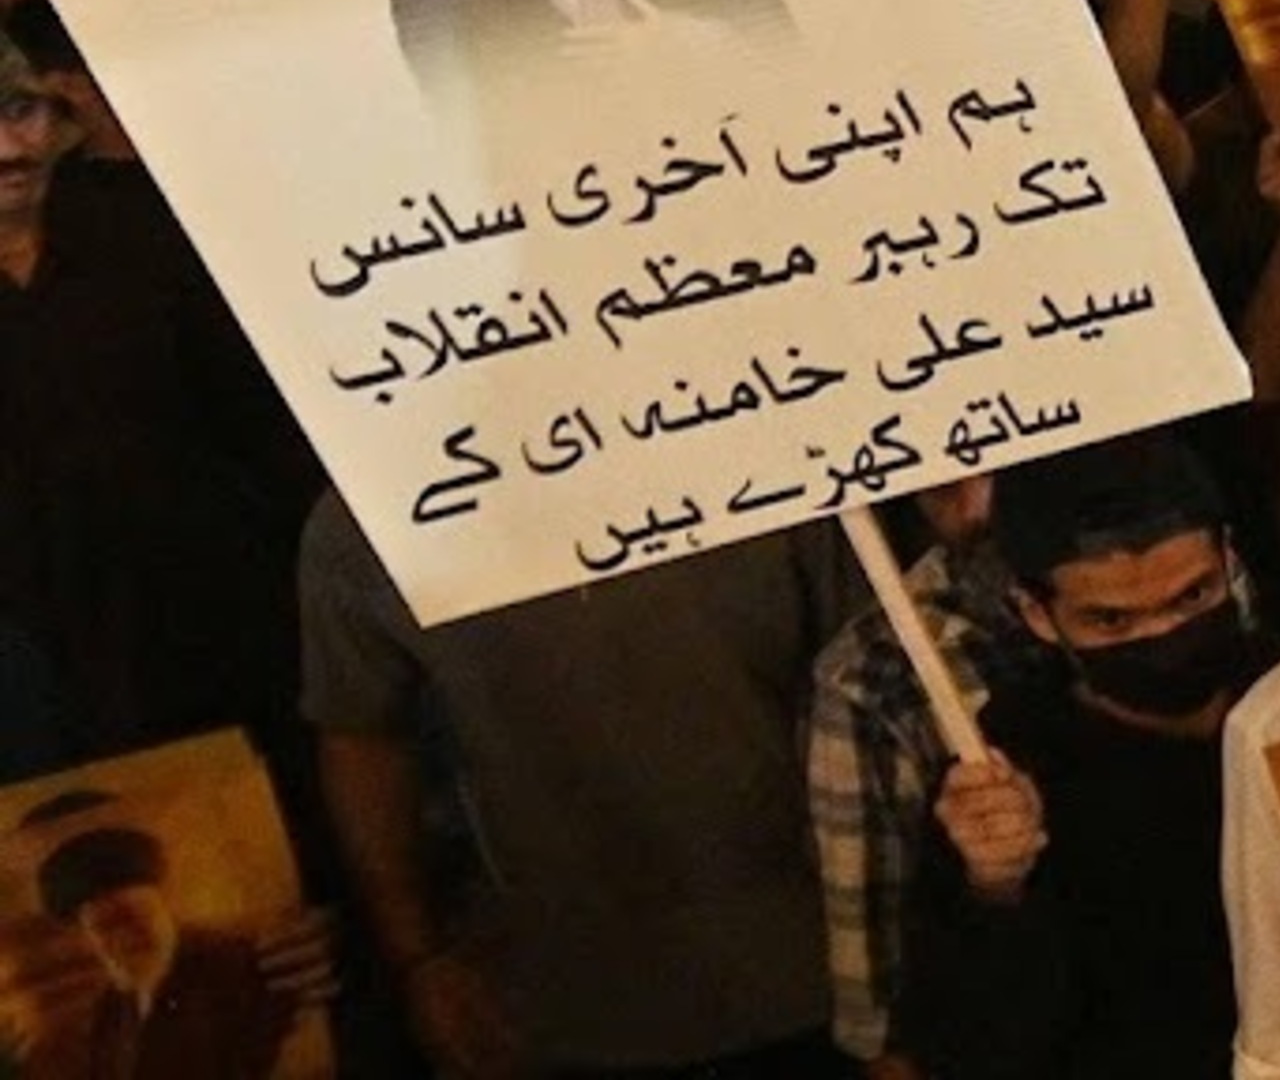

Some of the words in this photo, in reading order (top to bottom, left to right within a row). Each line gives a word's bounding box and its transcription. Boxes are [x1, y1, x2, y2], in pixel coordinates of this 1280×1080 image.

[775, 89, 922, 184] اپنی
[947, 78, 1037, 152] ہم
[993, 157, 1107, 225] تک
[310, 192, 527, 297] سانس
[852, 213, 980, 284] رہبر
[595, 244, 817, 349] معظم
[1026, 284, 1155, 342] سید
[331, 289, 568, 407] انقلاب
[876, 313, 1003, 393] علی
[521, 407, 603, 476] ای
[726, 414, 922, 514] کھڑے
[944, 392, 1081, 466] ساتھ
[410, 425, 502, 524] کے
[574, 496, 705, 572] ہیں
